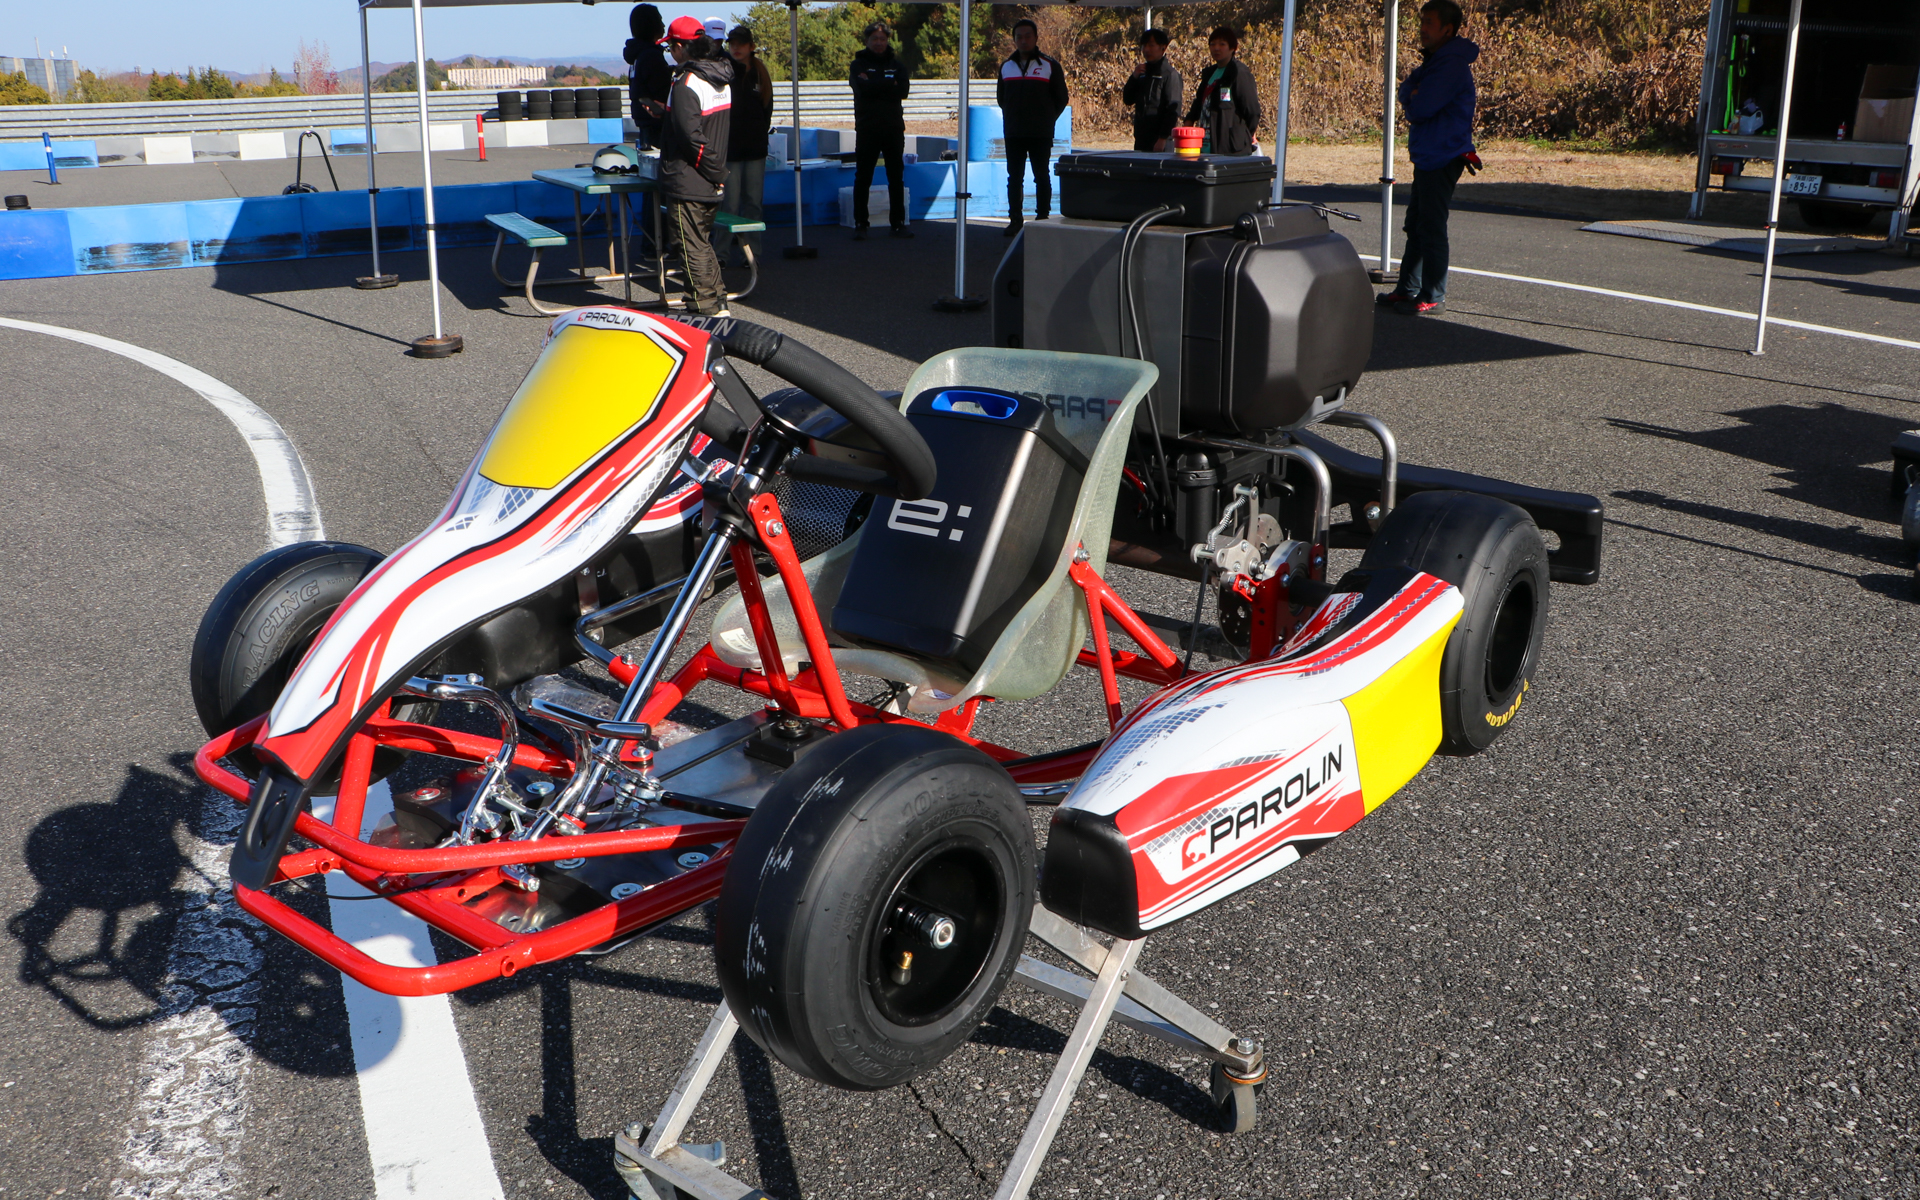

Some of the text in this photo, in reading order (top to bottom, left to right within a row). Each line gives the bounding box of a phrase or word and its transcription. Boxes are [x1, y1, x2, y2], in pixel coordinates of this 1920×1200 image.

[1793, 181, 1819, 194] 89-15
[583, 312, 636, 327] PAROLIN
[242, 580, 321, 690] RACING
[1210, 743, 1342, 855] PAROLIN
